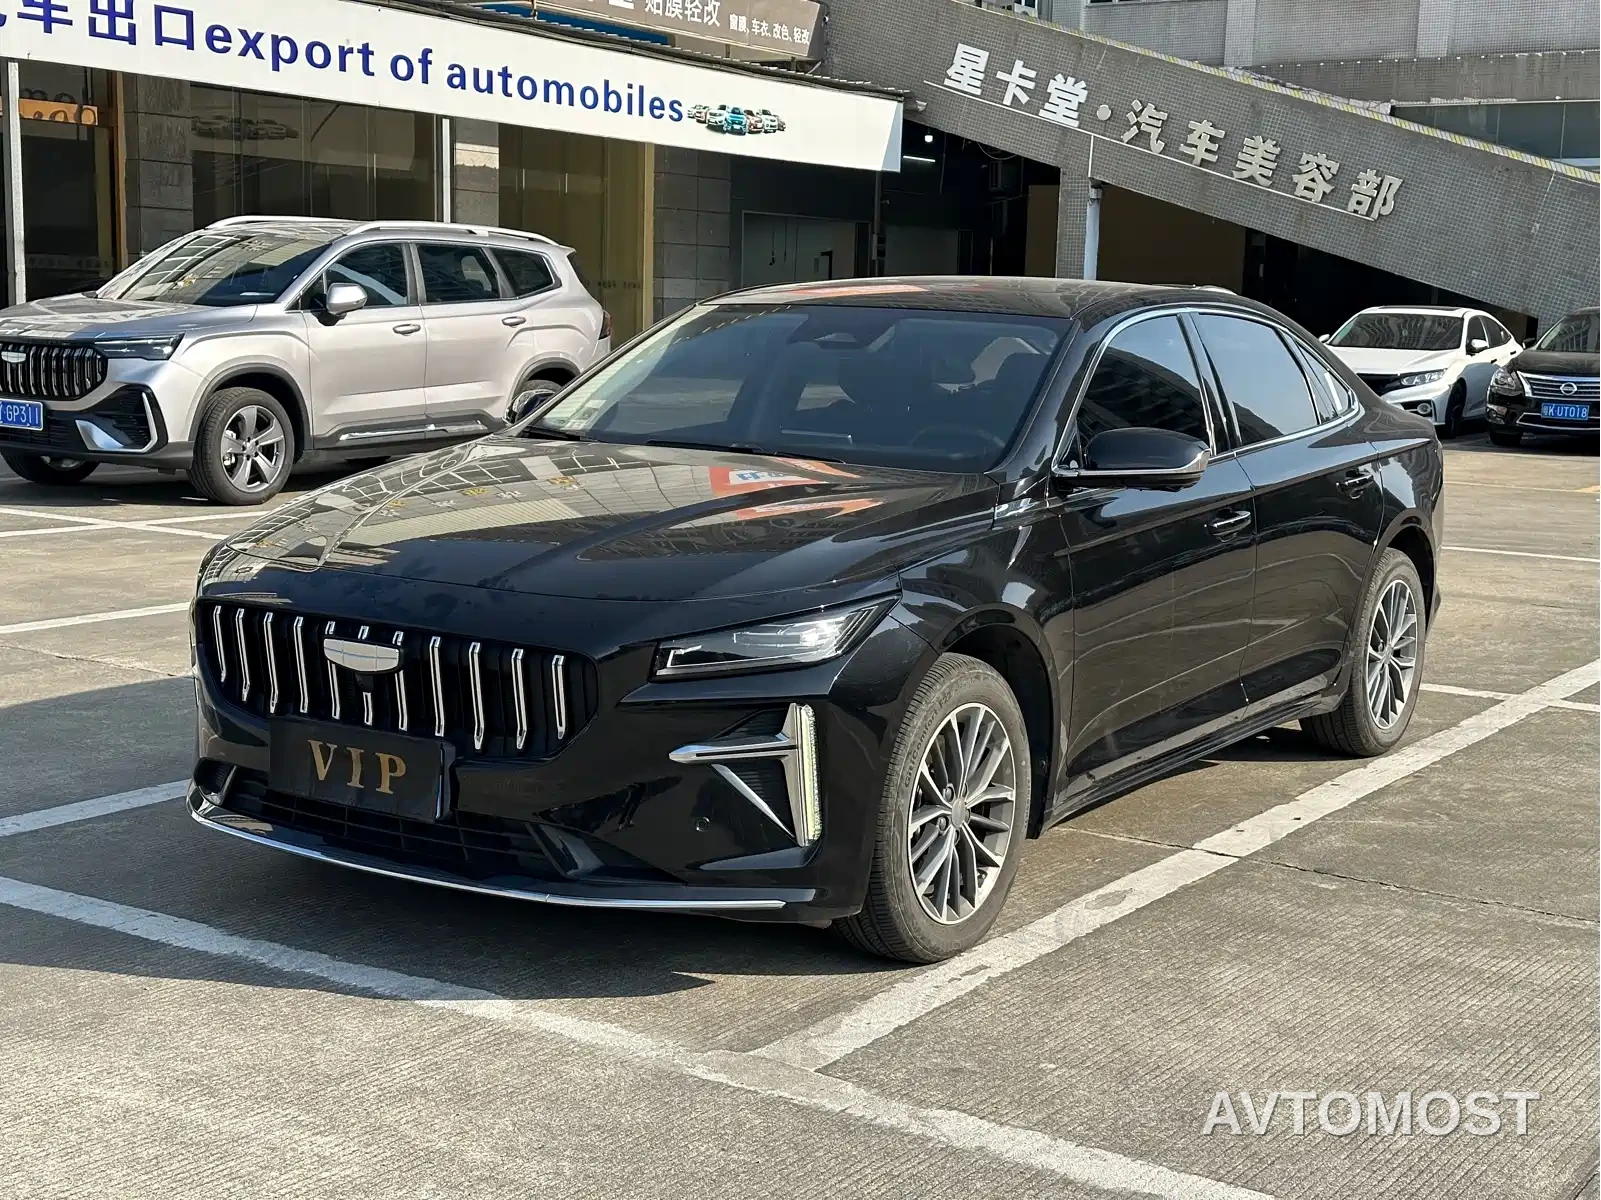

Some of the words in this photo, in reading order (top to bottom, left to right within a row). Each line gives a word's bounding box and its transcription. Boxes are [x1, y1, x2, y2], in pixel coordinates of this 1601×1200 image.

[0, 0, 195, 50] 车出口
[205, 24, 375, 77] export
[390, 48, 433, 84] of
[447, 64, 685, 123] automobiles
[307, 739, 407, 795] VIP
